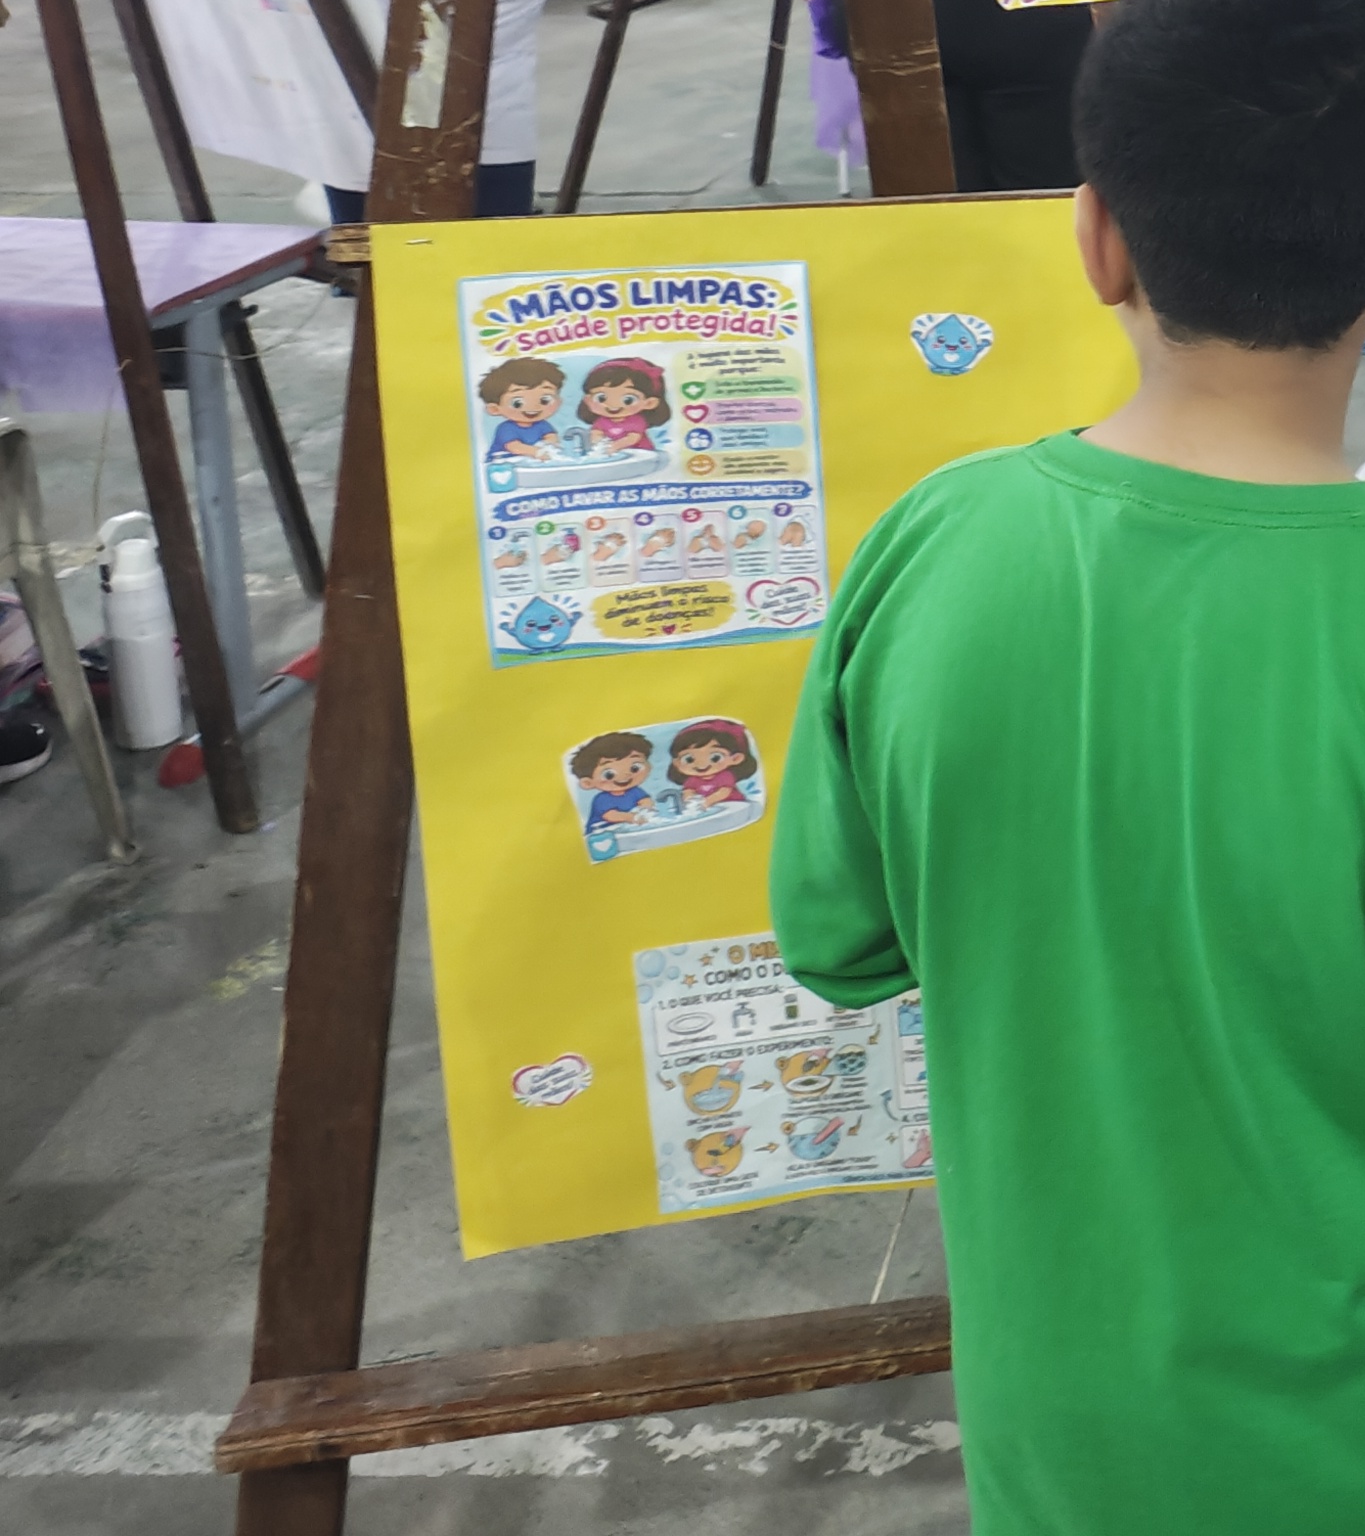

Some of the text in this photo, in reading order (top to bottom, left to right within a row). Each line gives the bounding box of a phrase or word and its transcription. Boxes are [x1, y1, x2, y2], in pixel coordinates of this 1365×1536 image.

[506, 278, 779, 324] MÃOS LIMPAS:
[515, 309, 777, 352] saúde protegida!
[505, 496, 561, 517] COMO
[562, 490, 615, 507] LAVAR
[617, 488, 640, 503] AS
[641, 484, 688, 502] MÃOS
[727, 944, 746, 964] O
[704, 966, 753, 987] COMO
[756, 966, 768, 979] O
